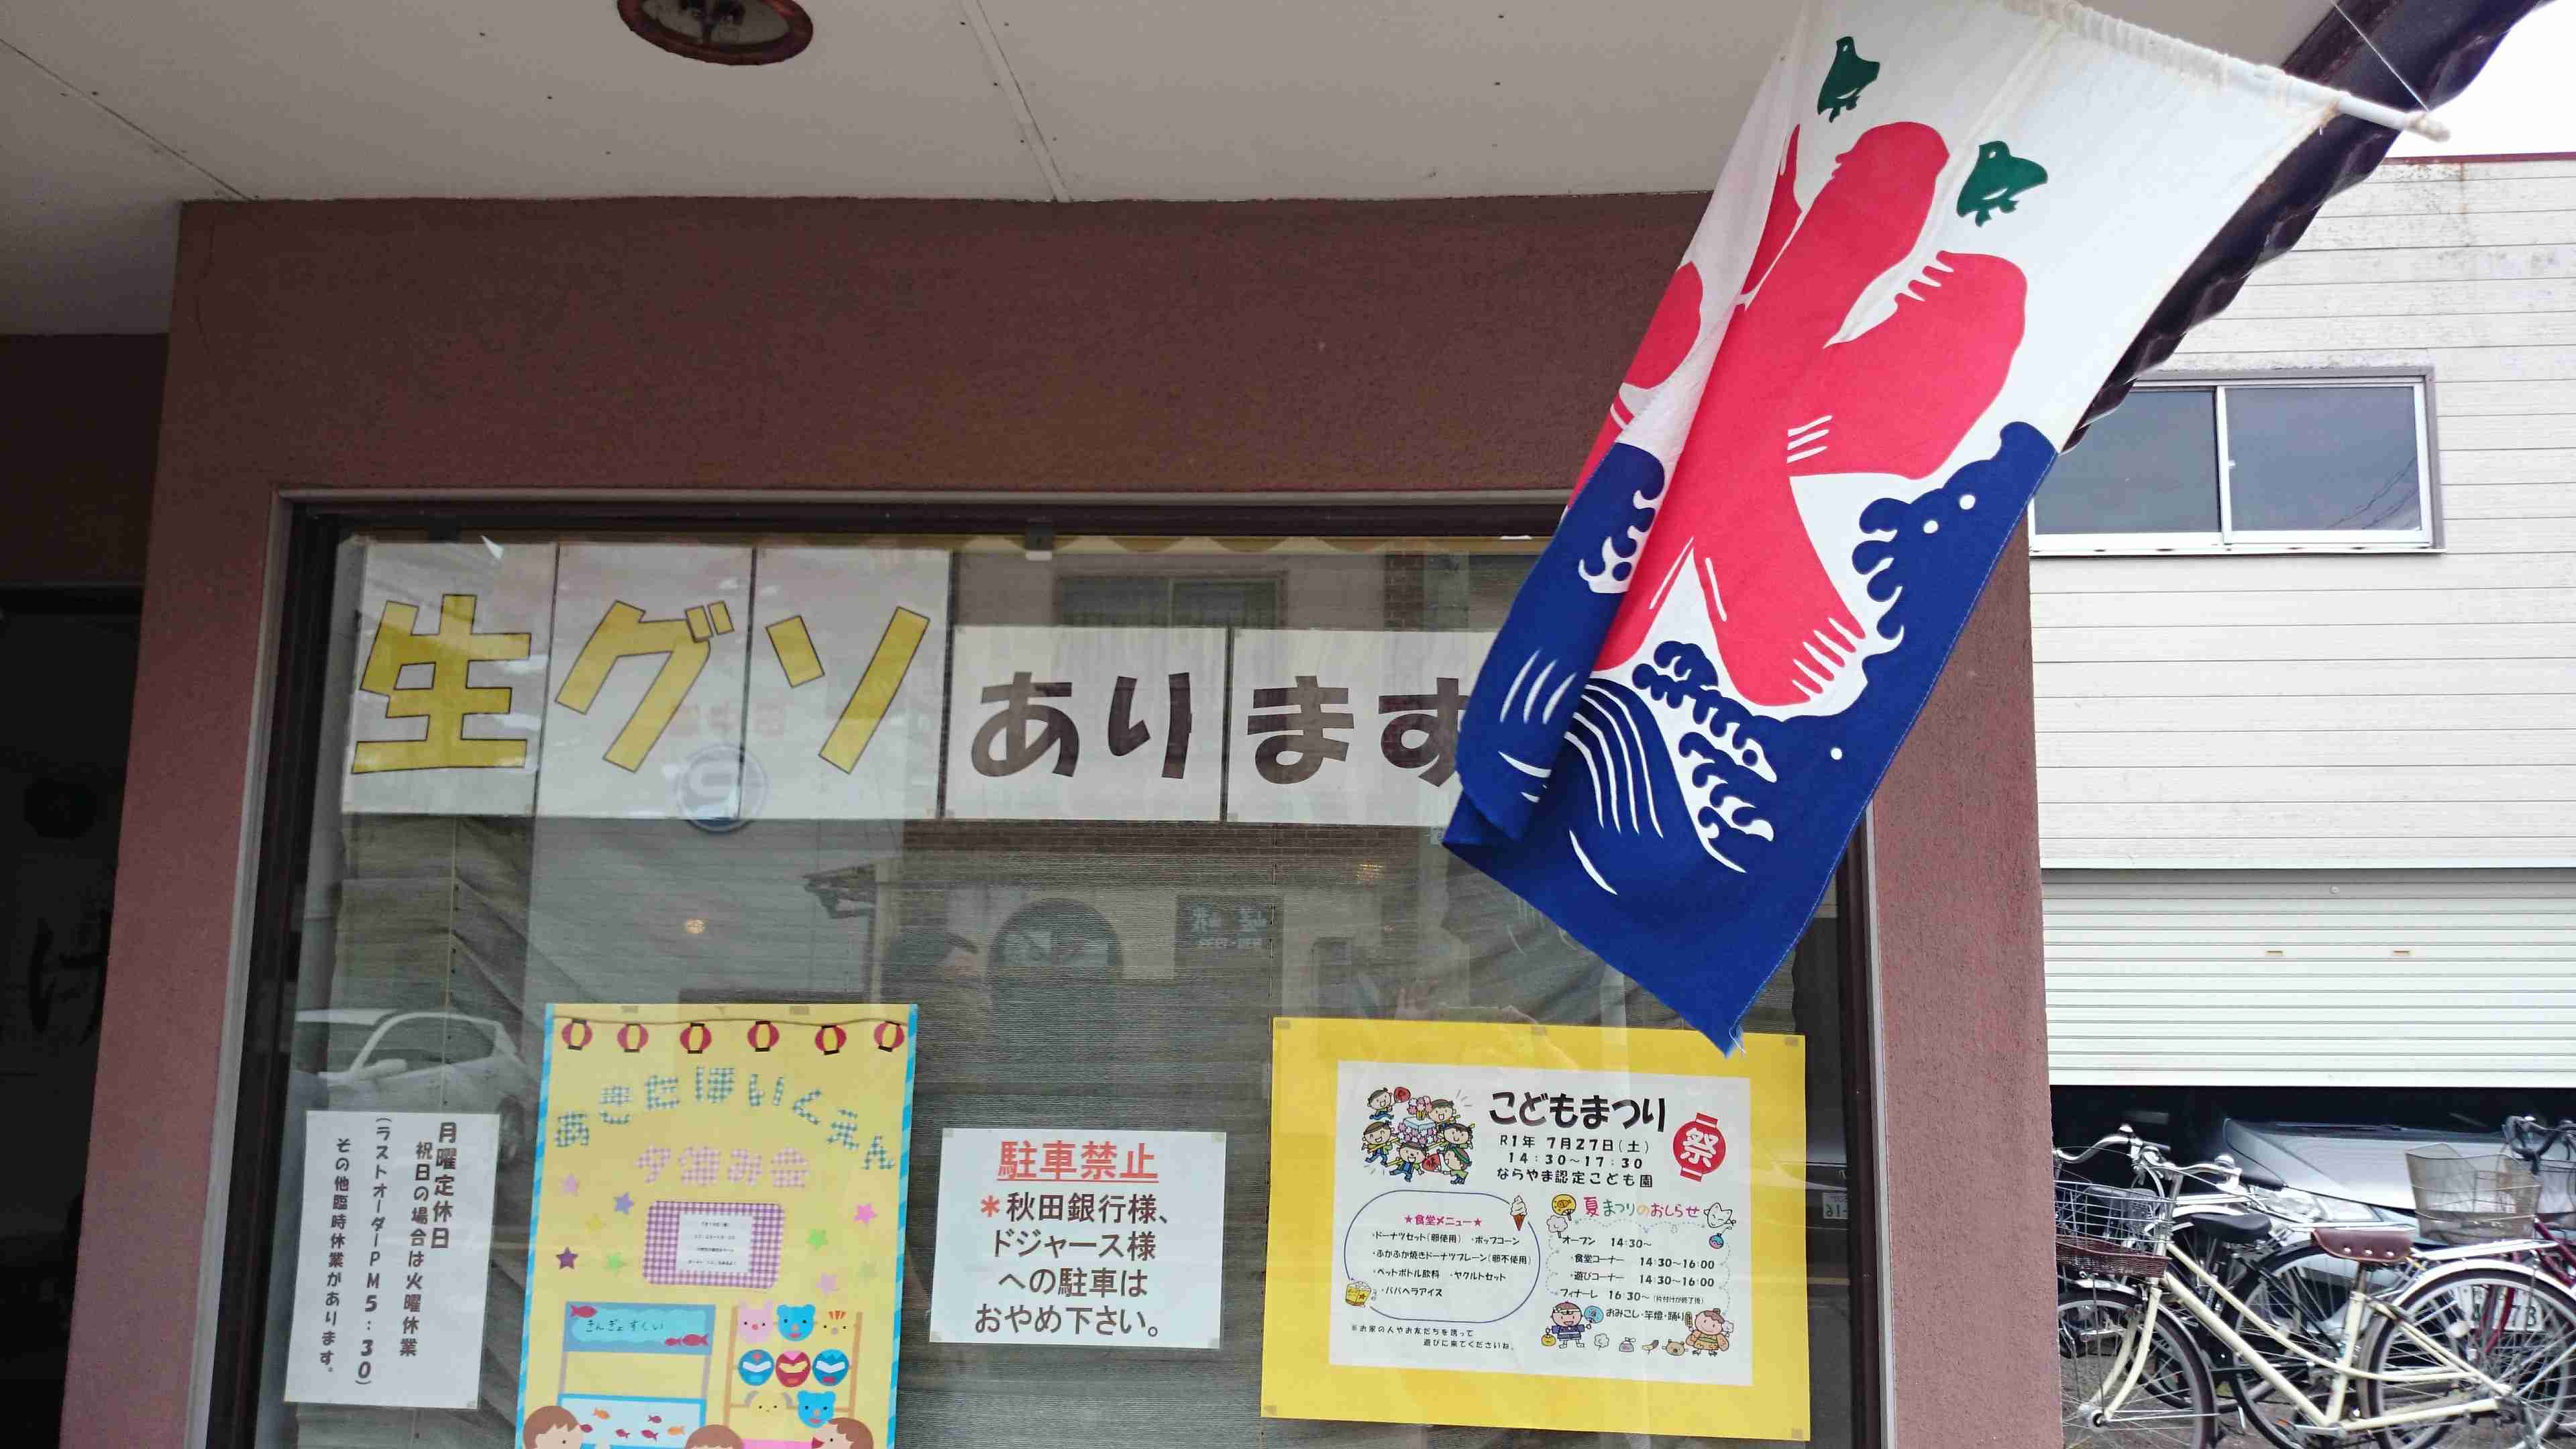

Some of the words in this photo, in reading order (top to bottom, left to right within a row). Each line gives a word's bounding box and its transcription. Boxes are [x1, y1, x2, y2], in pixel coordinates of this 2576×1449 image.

[971, 671, 1471, 788] あります
[1489, 1090, 1665, 1133] こどもまつり
[998, 1140, 1159, 1181] 駐車禁止
[1680, 1127, 1719, 1168] 祭
[431, 1121, 458, 1250] 月曜定休日
[1497, 1168, 1654, 1188] ならやま認定こども園
[1583, 1196, 1700, 1218] 夏まつりのおしらせ
[319, 1138, 352, 1373] その他臨時休業があります。
[399, 1141, 433, 1357] 祝日の場合は火曜休業
[994, 1230, 1157, 1261] ドジャース様
[998, 1267, 1148, 1297] への駐車は
[1560, 1289, 1598, 1299] フィナーレ
[975, 1303, 1159, 1338] おやめ下さい。
